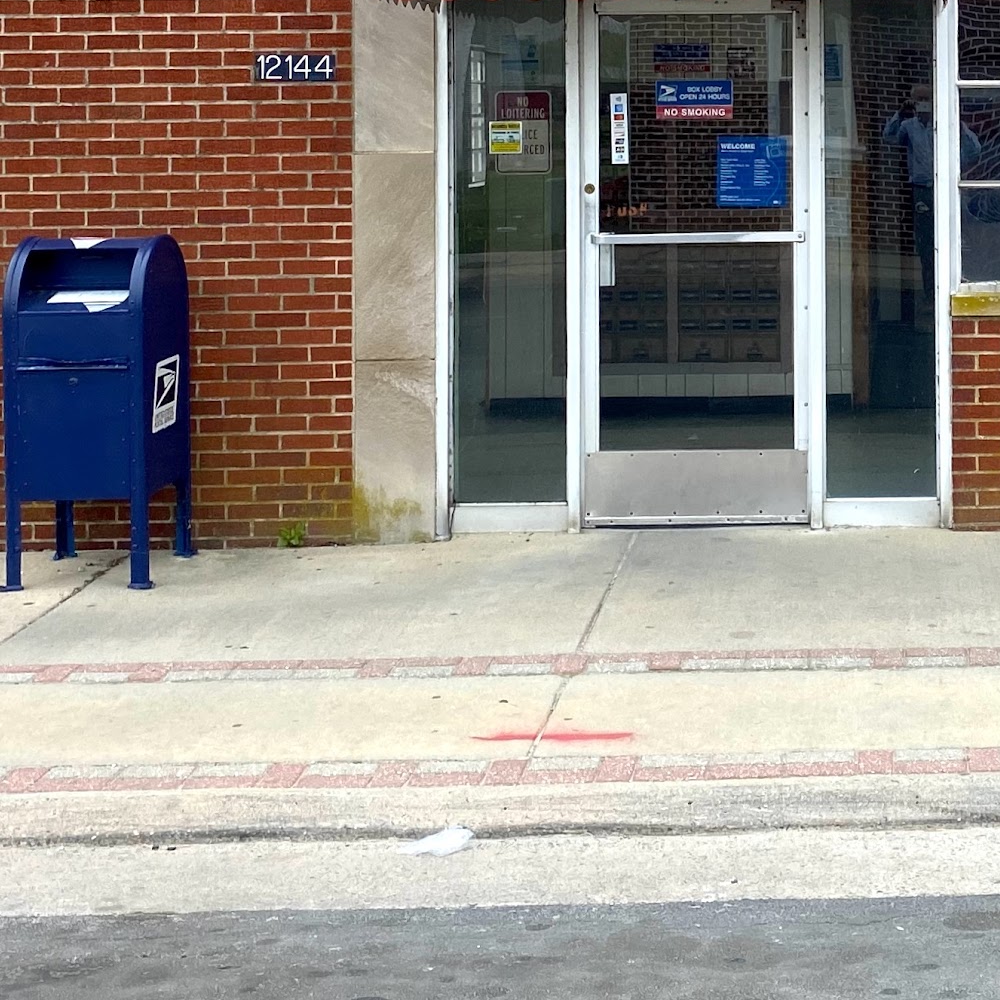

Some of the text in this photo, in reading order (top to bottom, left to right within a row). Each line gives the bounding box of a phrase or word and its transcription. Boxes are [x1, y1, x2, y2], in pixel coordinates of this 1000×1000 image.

[256, 55, 333, 80] 12144
[517, 96, 529, 107] NO
[679, 93, 698, 101] OPEN
[699, 93, 707, 101] 24
[708, 93, 731, 101] HOURS
[501, 108, 545, 119] LOITERING
[664, 108, 726, 117] NO SMOKING
